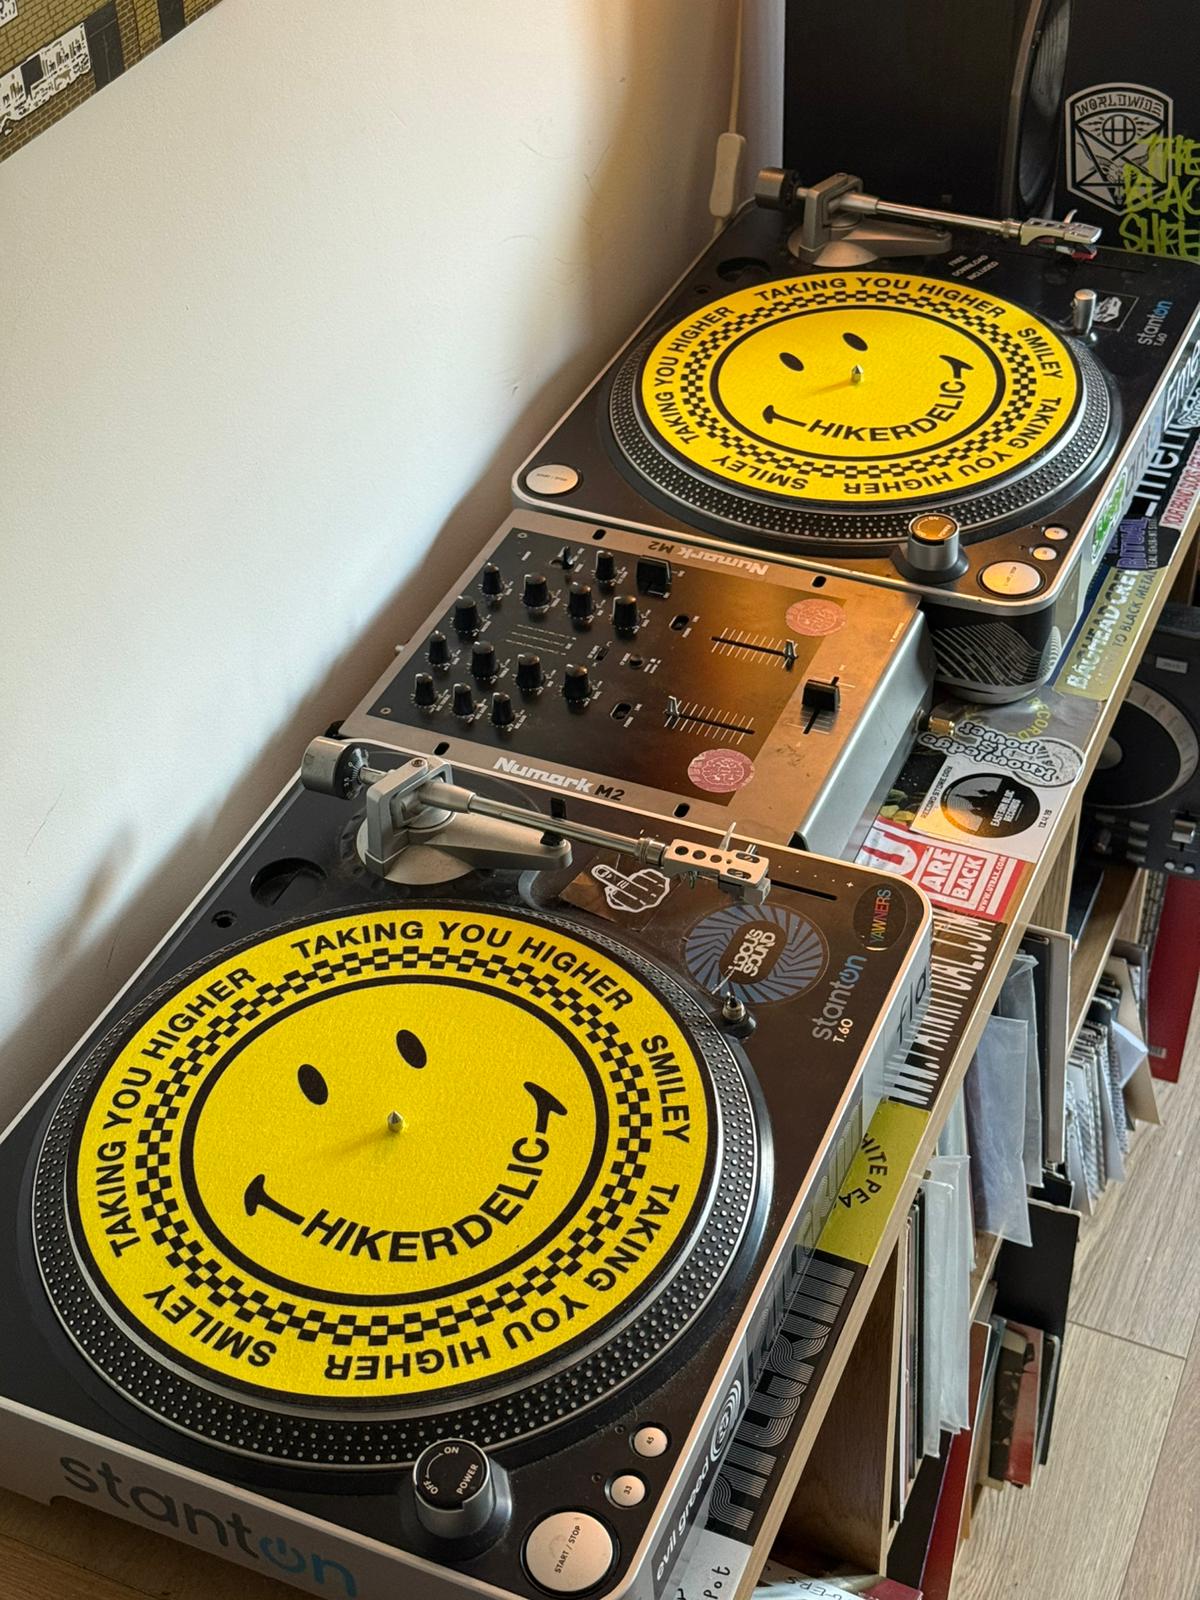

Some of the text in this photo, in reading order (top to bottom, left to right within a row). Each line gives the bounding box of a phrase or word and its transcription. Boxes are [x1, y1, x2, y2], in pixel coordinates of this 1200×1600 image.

[1076, 93, 1163, 117] WORLDWIDE
[754, 276, 1007, 319] TAKING YOU HIGHER
[1136, 299, 1173, 346] stanton
[654, 306, 735, 445] TAKING YOU HIGHER
[1016, 326, 1064, 380] SMILEY
[807, 380, 967, 443] HIKERDELIC
[843, 396, 1062, 495] TAKING YOU HIGHER
[711, 454, 810, 491] SMILEY
[648, 540, 769, 576] Numark M2
[1117, 516, 1149, 569] RITUAL
[1112, 634, 1128, 648] TO
[1120, 601, 1143, 632] BLACK
[1010, 696, 1051, 743] RECORD
[492, 756, 626, 801] Numark M2
[920, 795, 938, 819] RECORD
[932, 776, 948, 796] STORE
[989, 802, 1010, 828] EASTERN
[1002, 798, 1022, 823] RECORDS
[919, 847, 958, 894] ARE
[950, 855, 986, 901] BACK
[869, 888, 893, 944] YAWNERS
[290, 920, 634, 1012] TAKING YOU HIGHER
[742, 930, 777, 978] SOUND
[811, 953, 869, 1042] stanton
[832, 1017, 855, 1045] T.60
[95, 966, 257, 1258] TAKING YOU HIGHER
[640, 1034, 691, 1144] SMILEY
[836, 1132, 889, 1210] HITE PEA
[300, 1136, 551, 1263] HIKERDELIC
[323, 1183, 681, 1381] TAKING YOU HIGHER
[143, 1284, 278, 1368] SMILEY
[443, 1446, 460, 1455] ON
[422, 1480, 440, 1496] OFF
[455, 1463, 480, 1496] POWER
[623, 1485, 633, 1496] 33
[59, 1454, 358, 1598] stanton
[656, 1456, 710, 1582] evil greed
[553, 1550, 569, 1574] START
[568, 1525, 582, 1544] STOP
